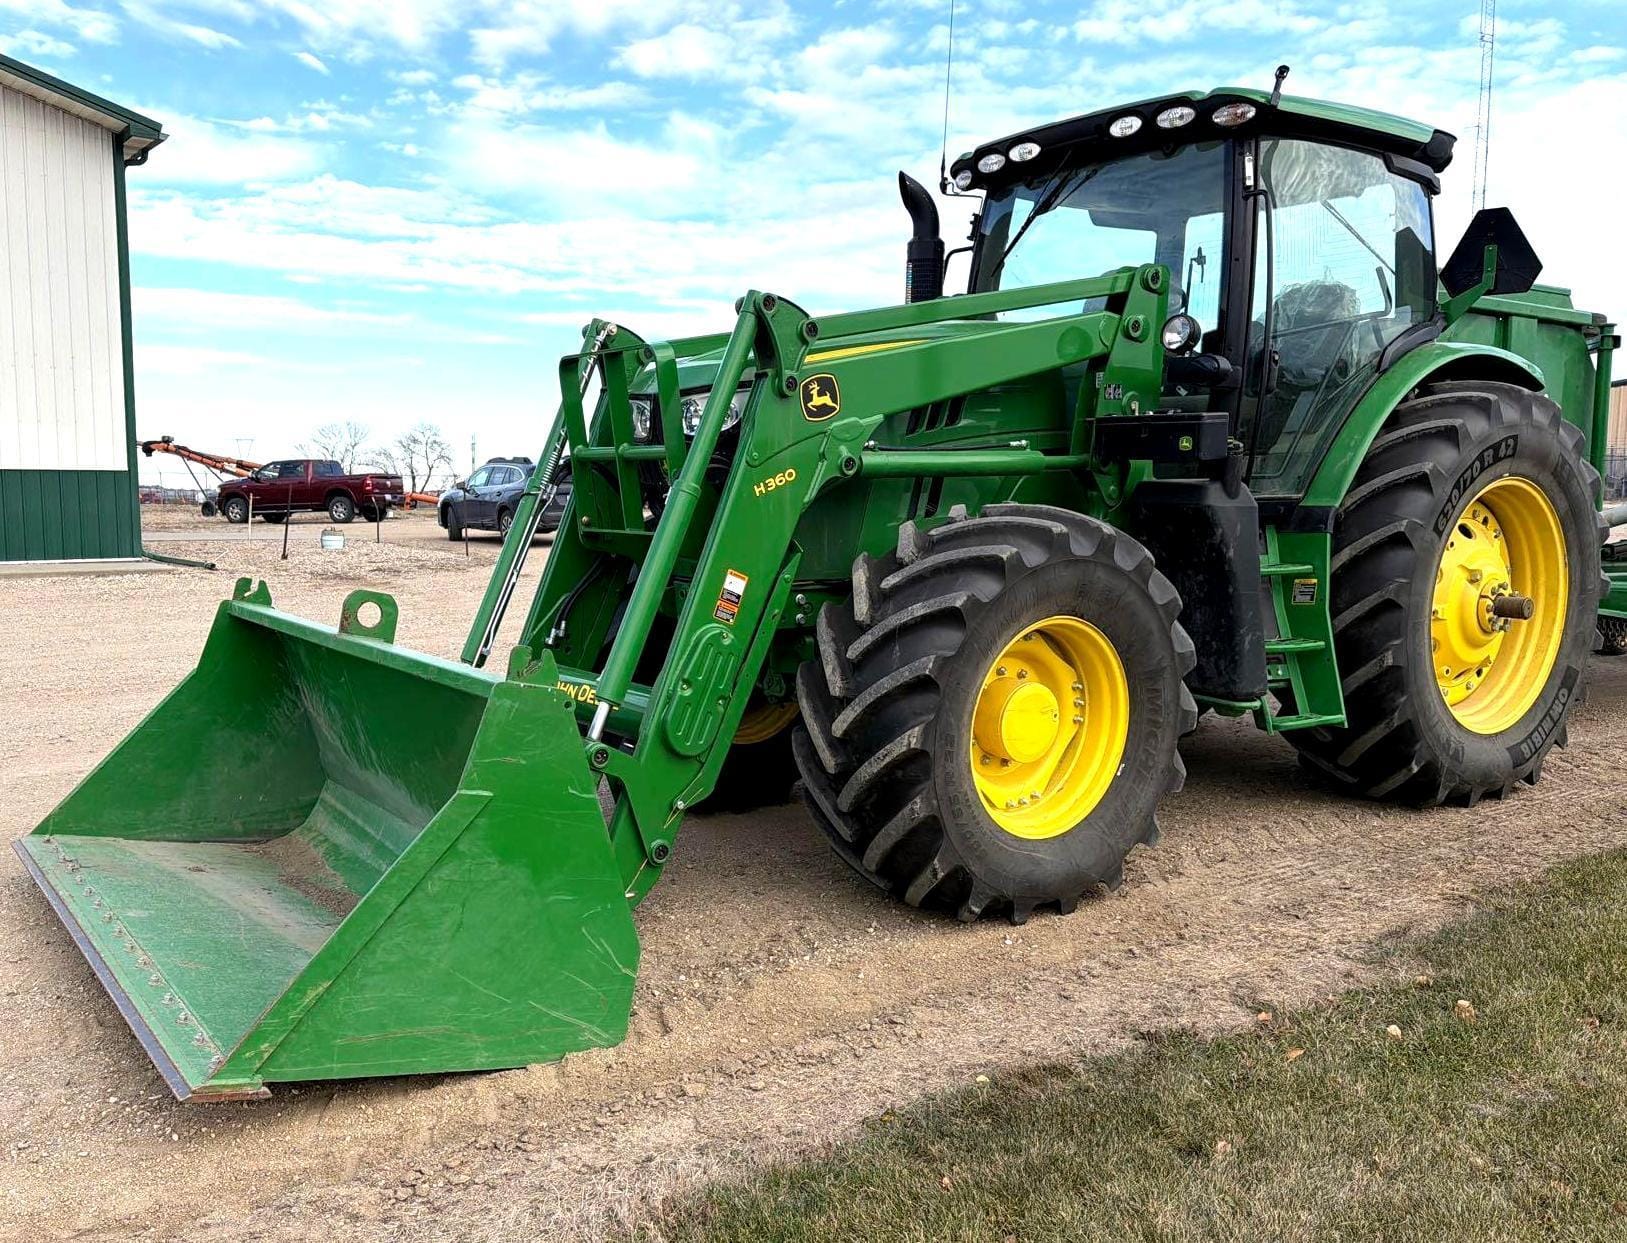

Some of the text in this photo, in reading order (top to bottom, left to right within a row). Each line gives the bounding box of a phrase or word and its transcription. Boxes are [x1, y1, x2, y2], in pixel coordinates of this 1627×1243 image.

[753, 468, 796, 497] H360
[1437, 438, 1515, 531] 620/70 R 42
